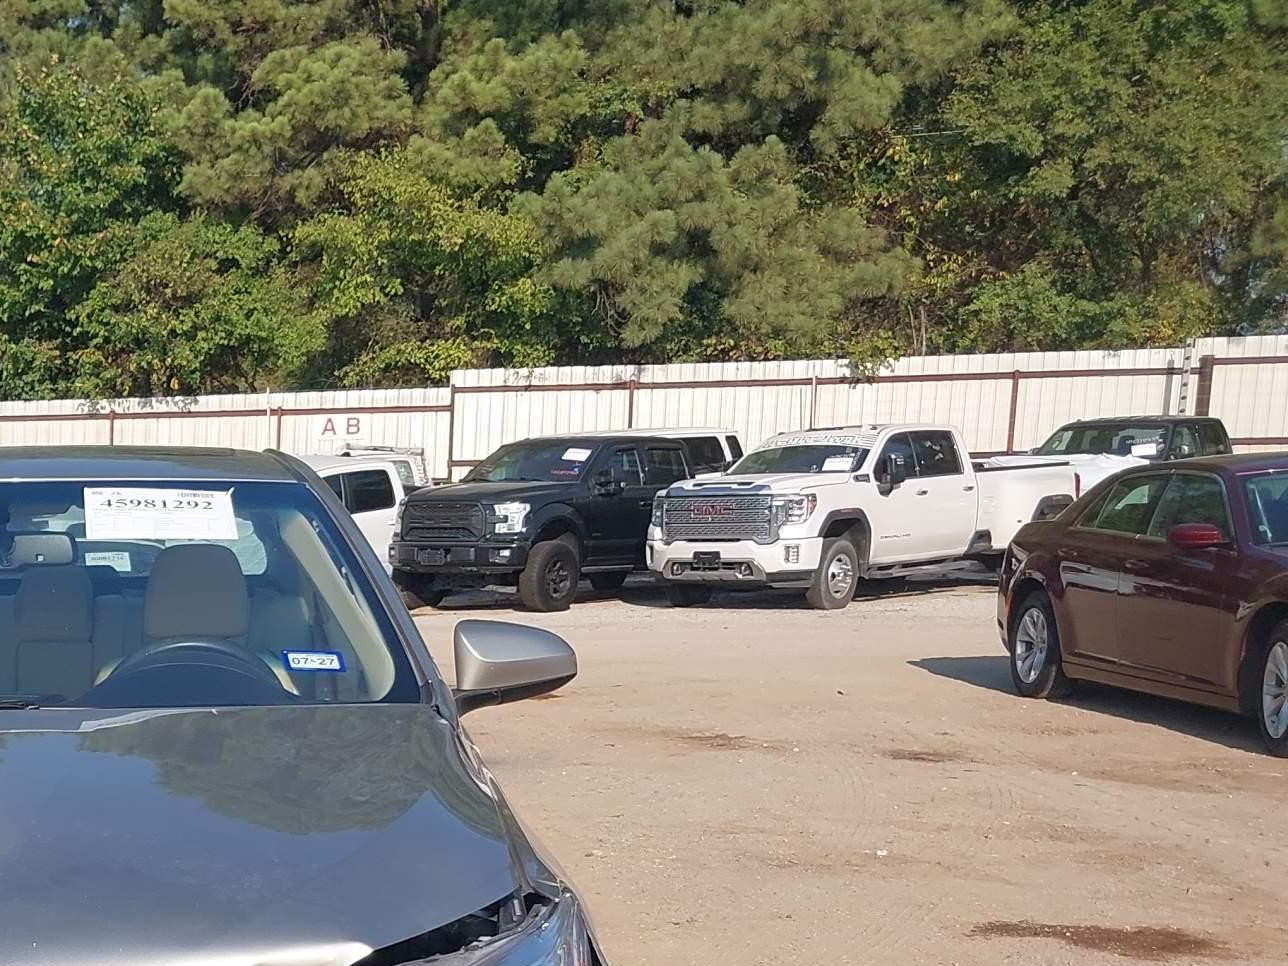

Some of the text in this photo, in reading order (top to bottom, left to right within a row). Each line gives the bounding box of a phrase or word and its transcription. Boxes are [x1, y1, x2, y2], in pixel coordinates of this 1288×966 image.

[321, 417, 361, 436] A B
[99, 498, 215, 510] 45981292
